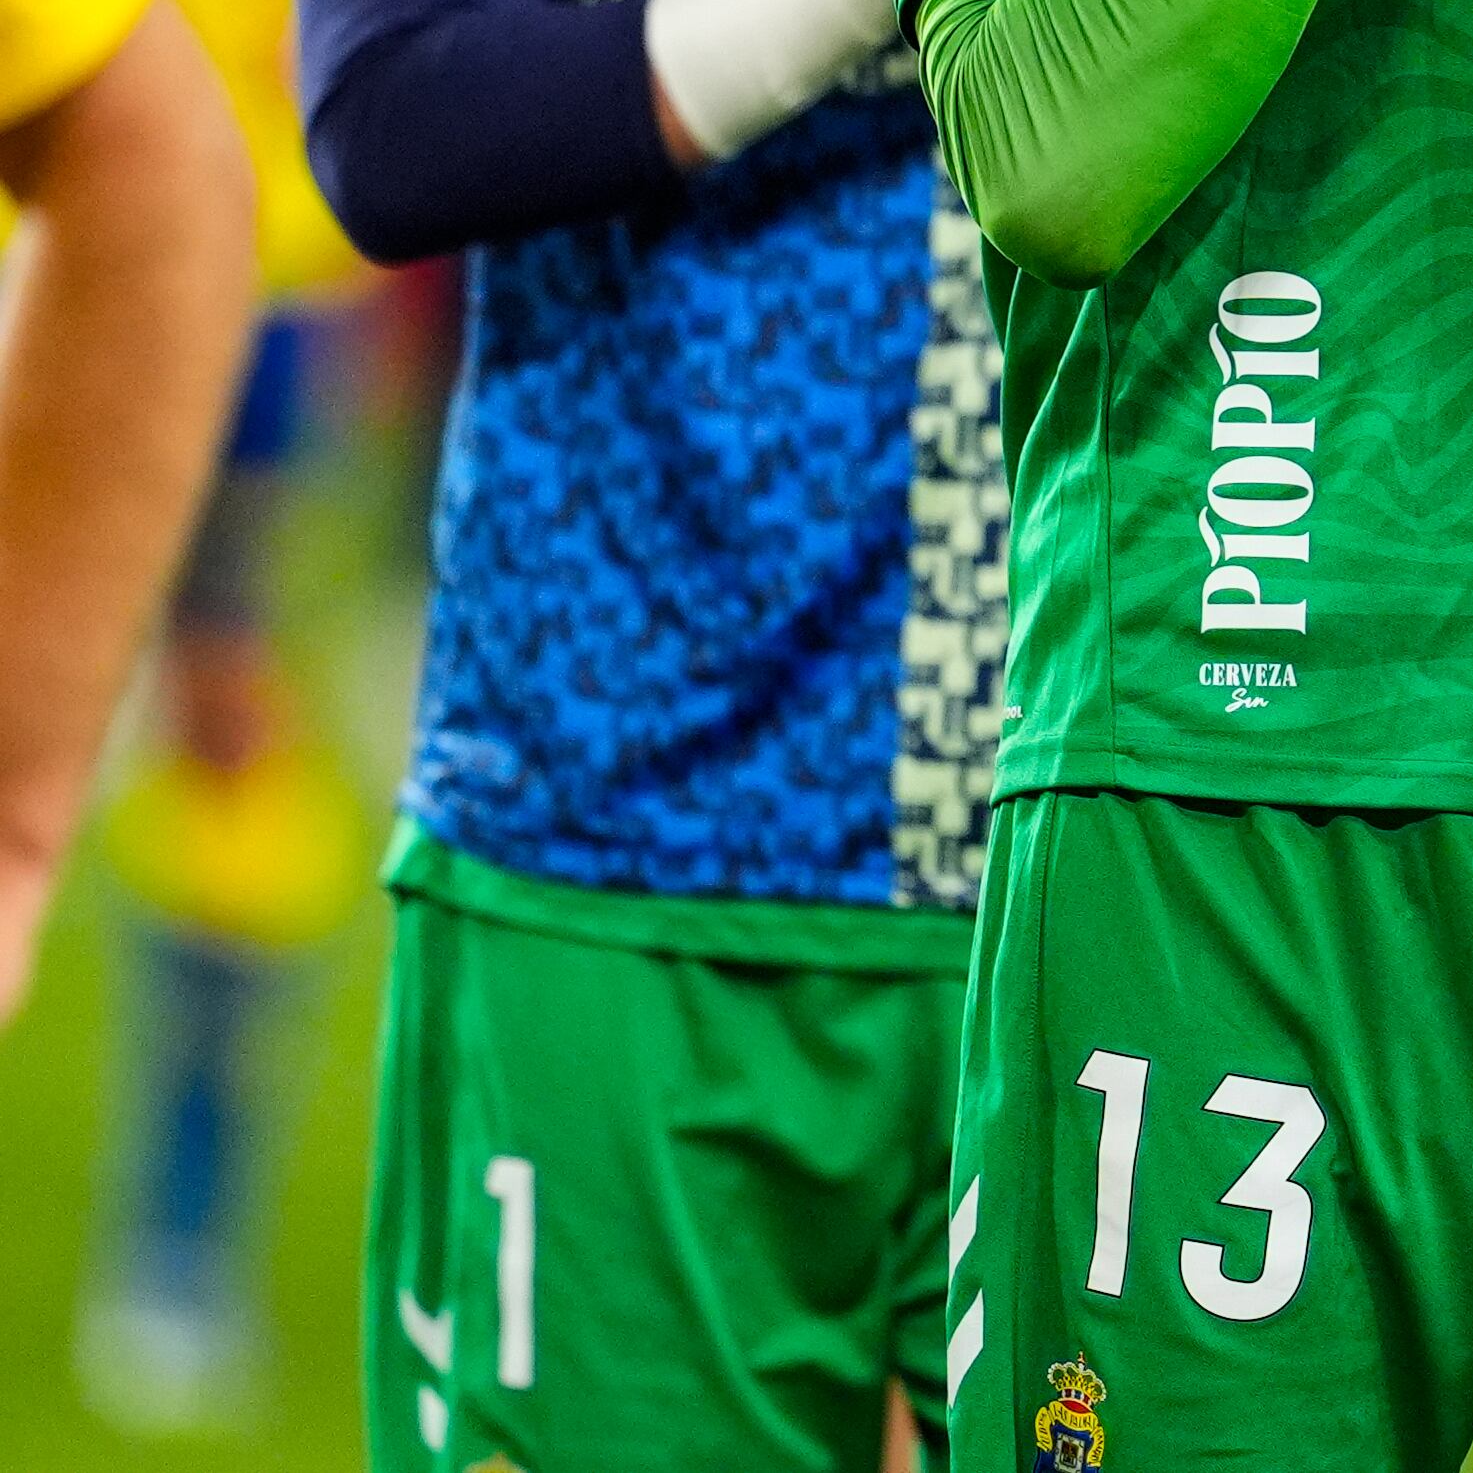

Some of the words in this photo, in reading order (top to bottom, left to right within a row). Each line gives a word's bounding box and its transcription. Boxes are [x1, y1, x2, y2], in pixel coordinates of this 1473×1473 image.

[1199, 662, 1298, 687] CERVEZA
[484, 1156, 537, 1390] 1
[1076, 1048, 1328, 1323] 13
